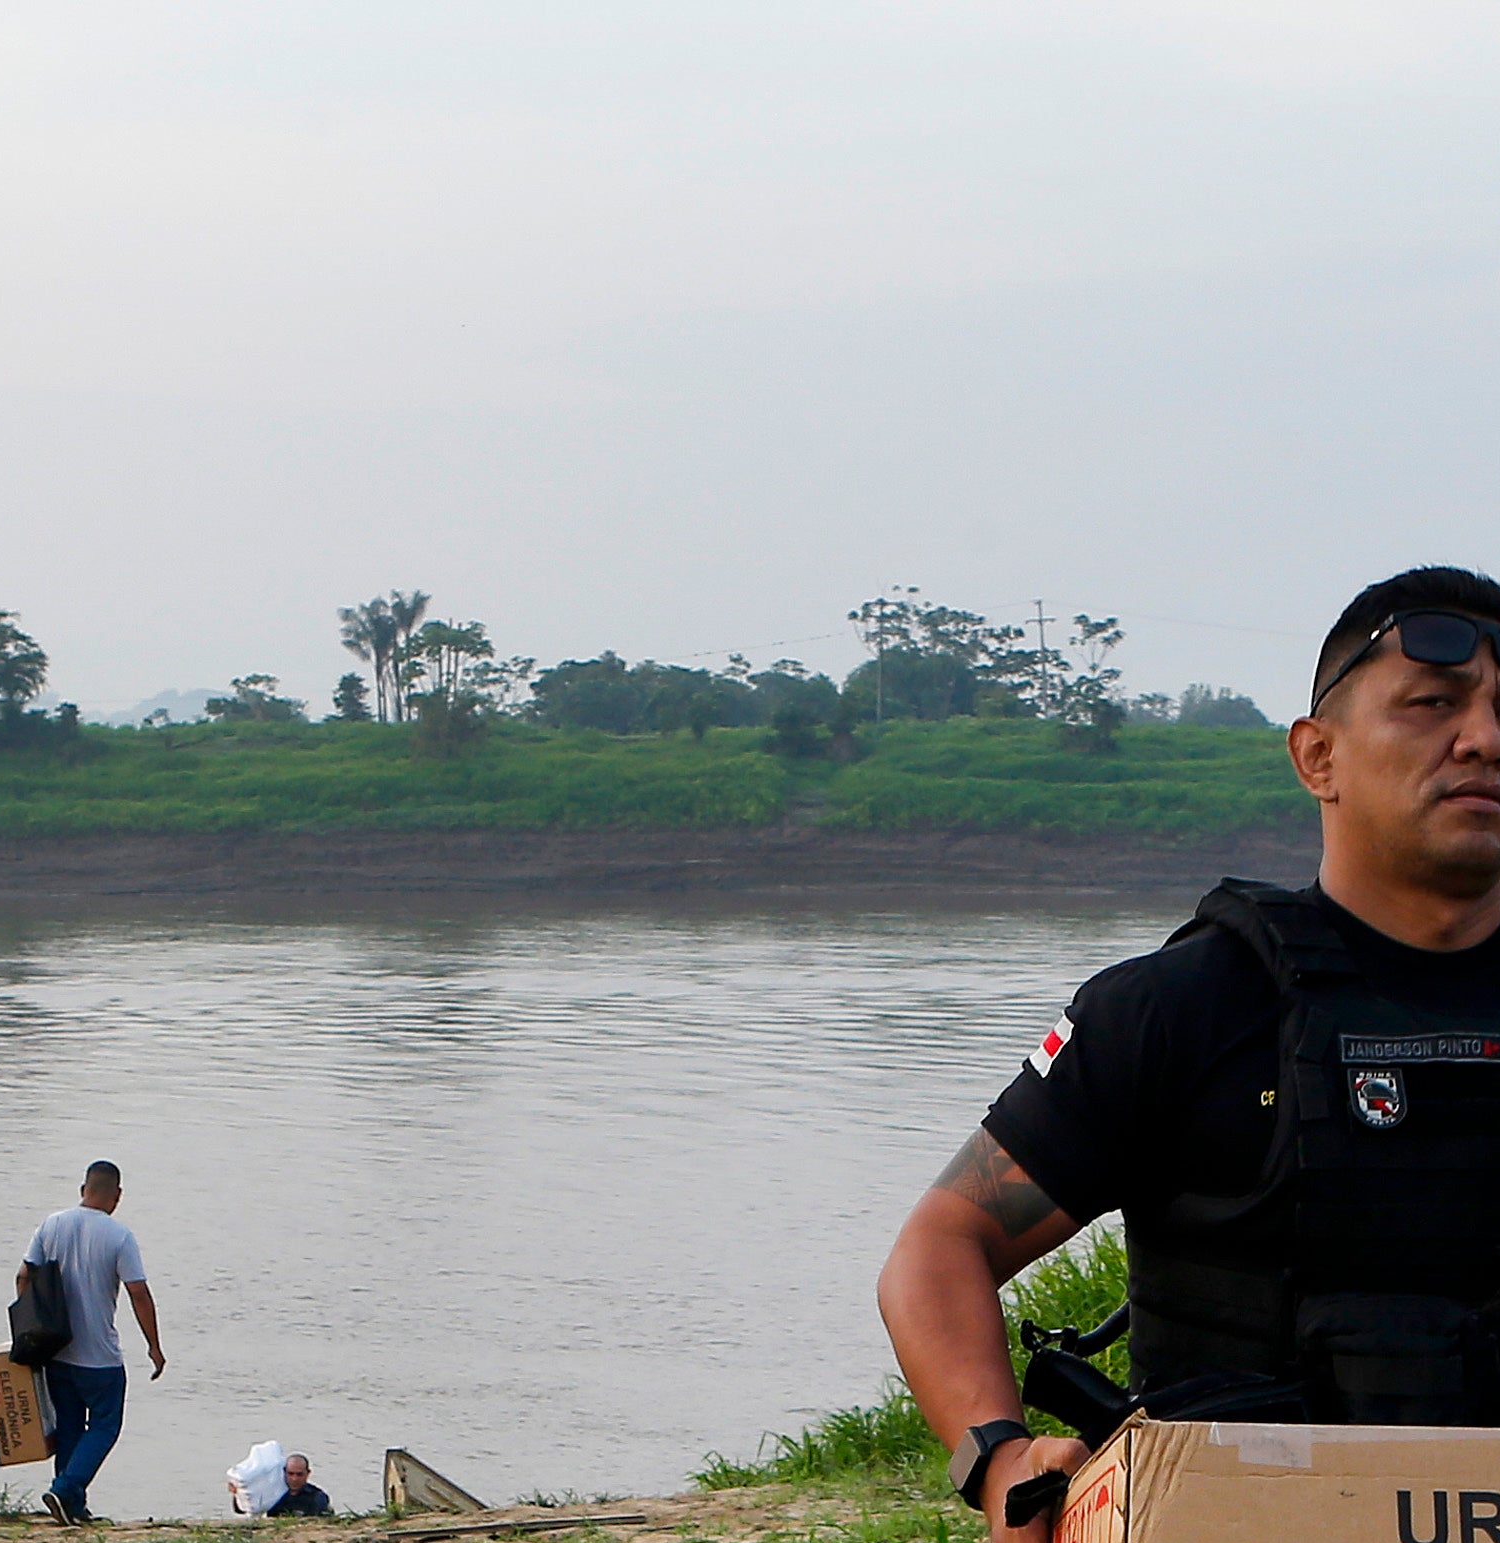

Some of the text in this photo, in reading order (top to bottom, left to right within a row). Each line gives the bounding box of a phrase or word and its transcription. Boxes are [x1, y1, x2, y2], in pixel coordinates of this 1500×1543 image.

[1348, 1038, 1481, 1058] JANDERSON PINTO
[0, 1370, 22, 1448] ELETRÔNICA
[17, 1390, 32, 1424] URNA
